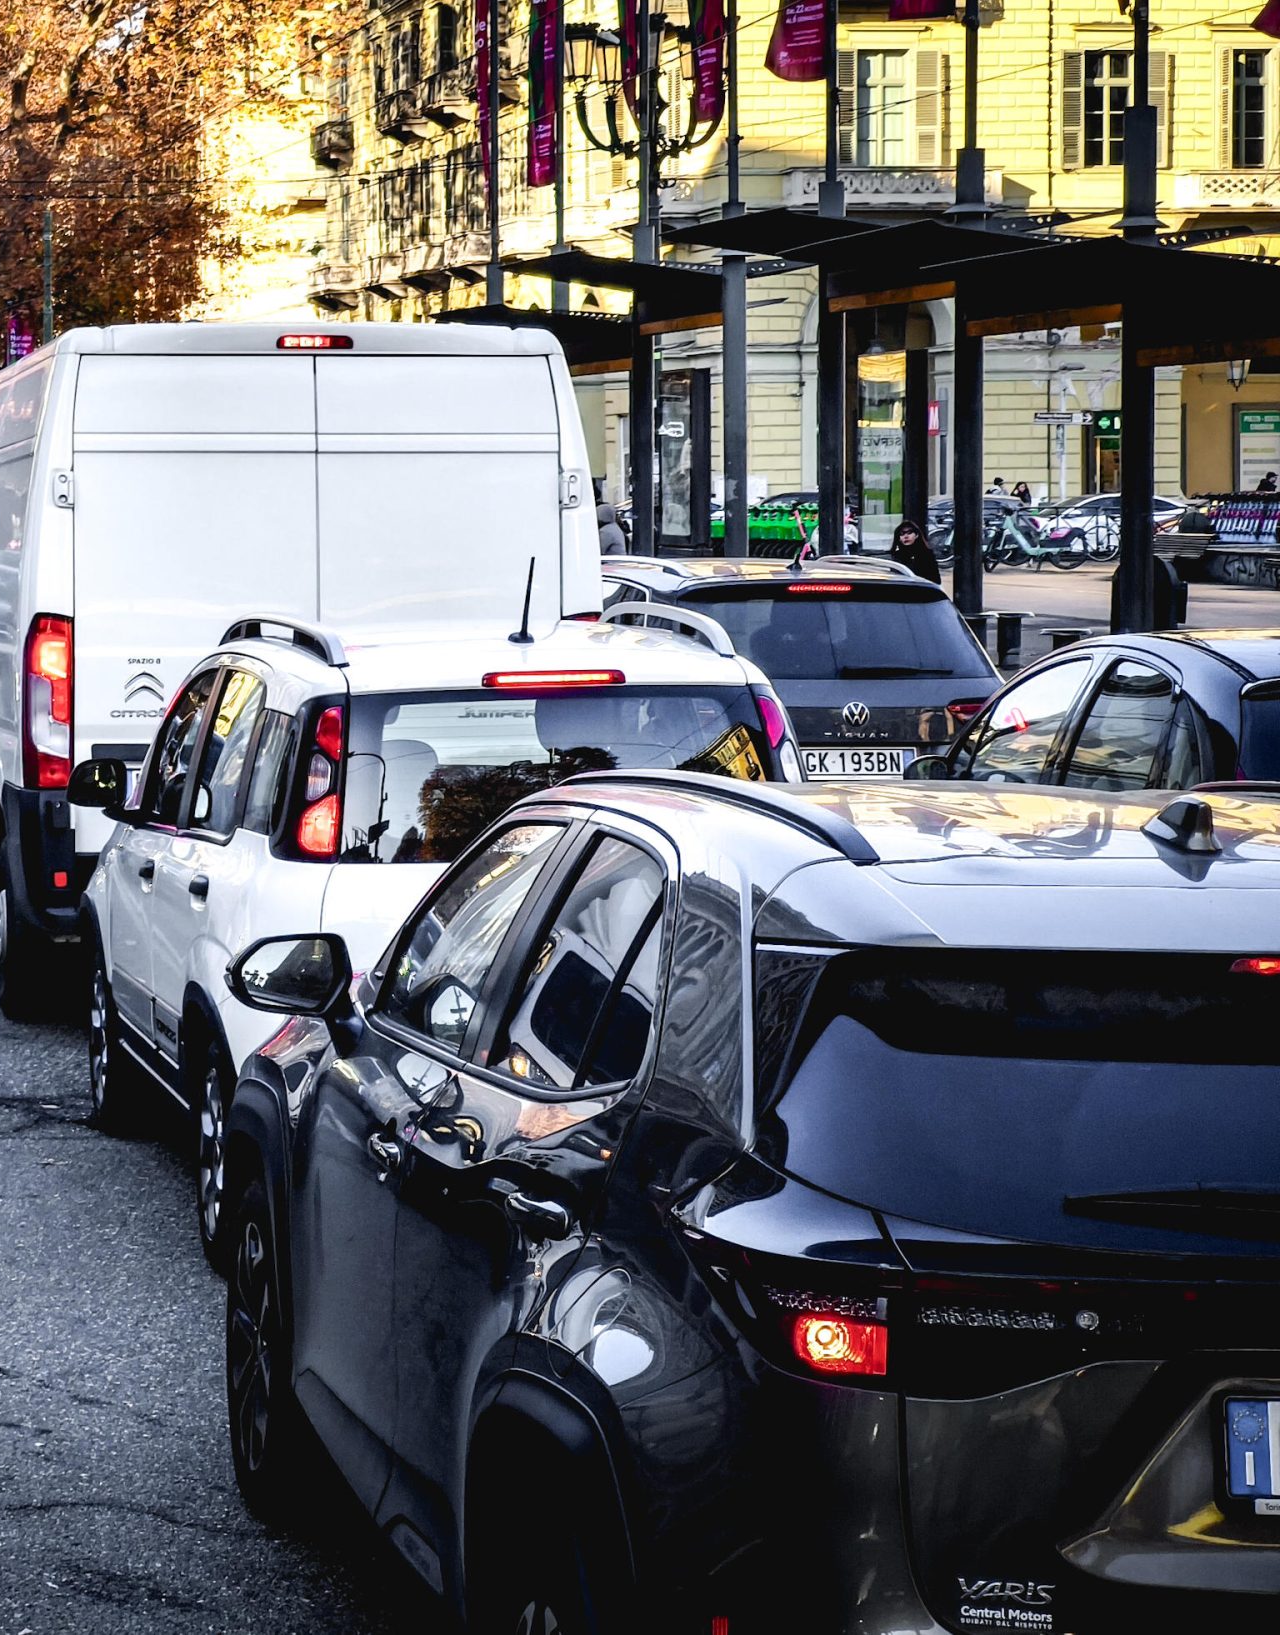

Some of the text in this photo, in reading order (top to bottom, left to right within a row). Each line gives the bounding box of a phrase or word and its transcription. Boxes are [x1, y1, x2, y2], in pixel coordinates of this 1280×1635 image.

[805, 752, 901, 773] GK 193BN
[961, 1605, 1052, 1622] Central Motors
